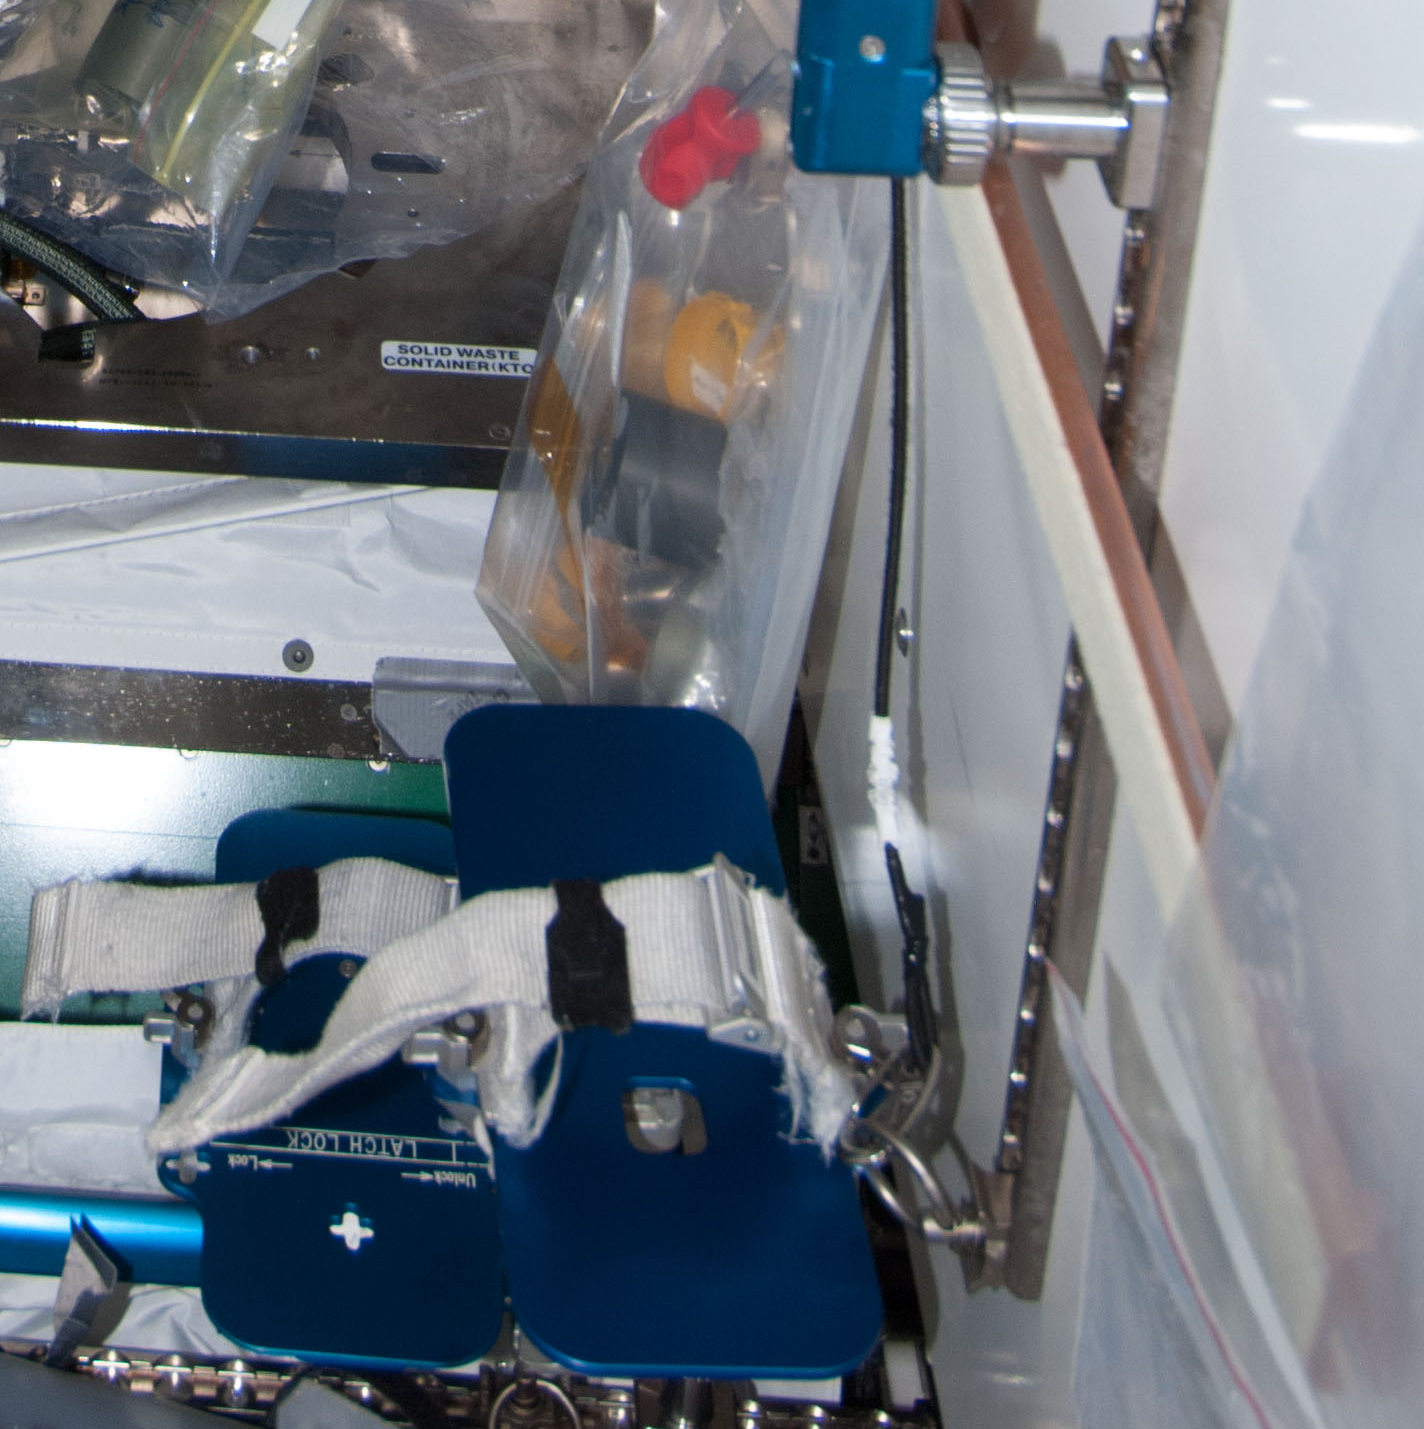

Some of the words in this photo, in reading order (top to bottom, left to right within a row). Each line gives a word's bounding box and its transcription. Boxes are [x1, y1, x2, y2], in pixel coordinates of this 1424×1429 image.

[397, 344, 453, 357] SOLID
[456, 347, 520, 361] WASTE
[286, 1130, 340, 1152] LOCK
[349, 1136, 418, 1159] LATCH
[228, 1153, 259, 1171] Lock
[433, 1170, 477, 1189] Unlock
